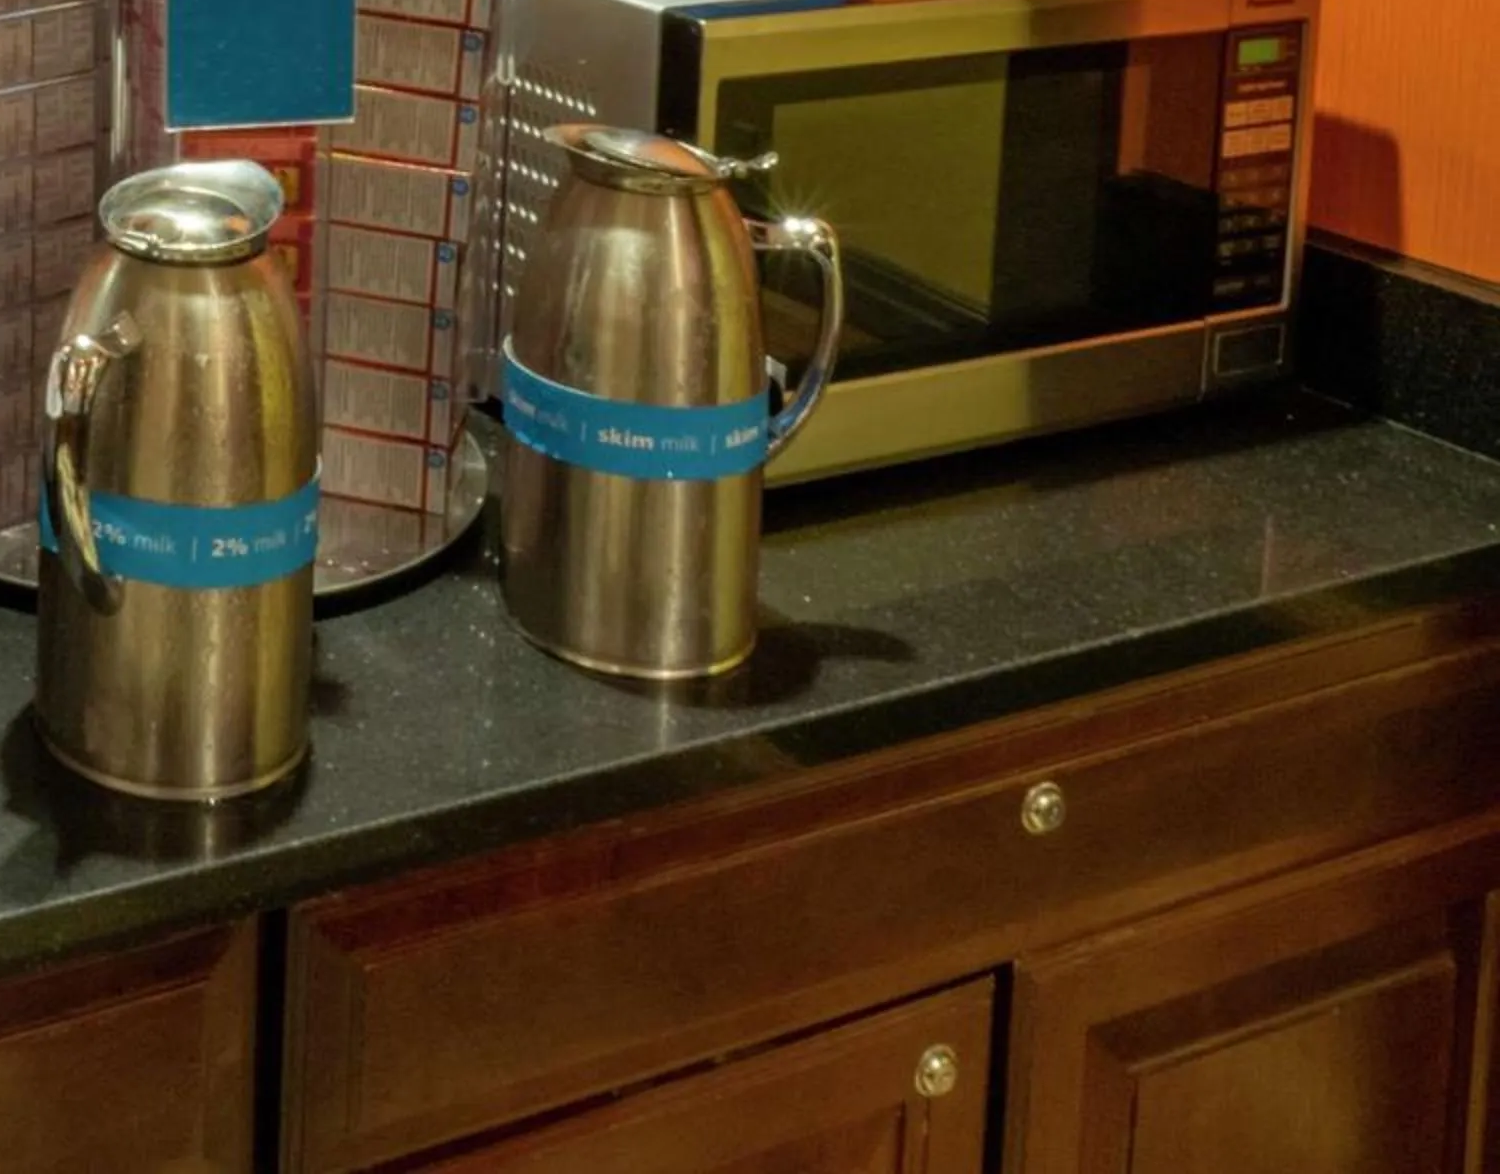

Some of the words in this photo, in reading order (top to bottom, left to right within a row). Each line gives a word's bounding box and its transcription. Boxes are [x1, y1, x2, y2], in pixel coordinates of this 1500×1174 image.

[597, 427, 655, 451] skim
[660, 434, 699, 452] milk
[131, 532, 177, 556] milk
[211, 537, 249, 558] 2%
